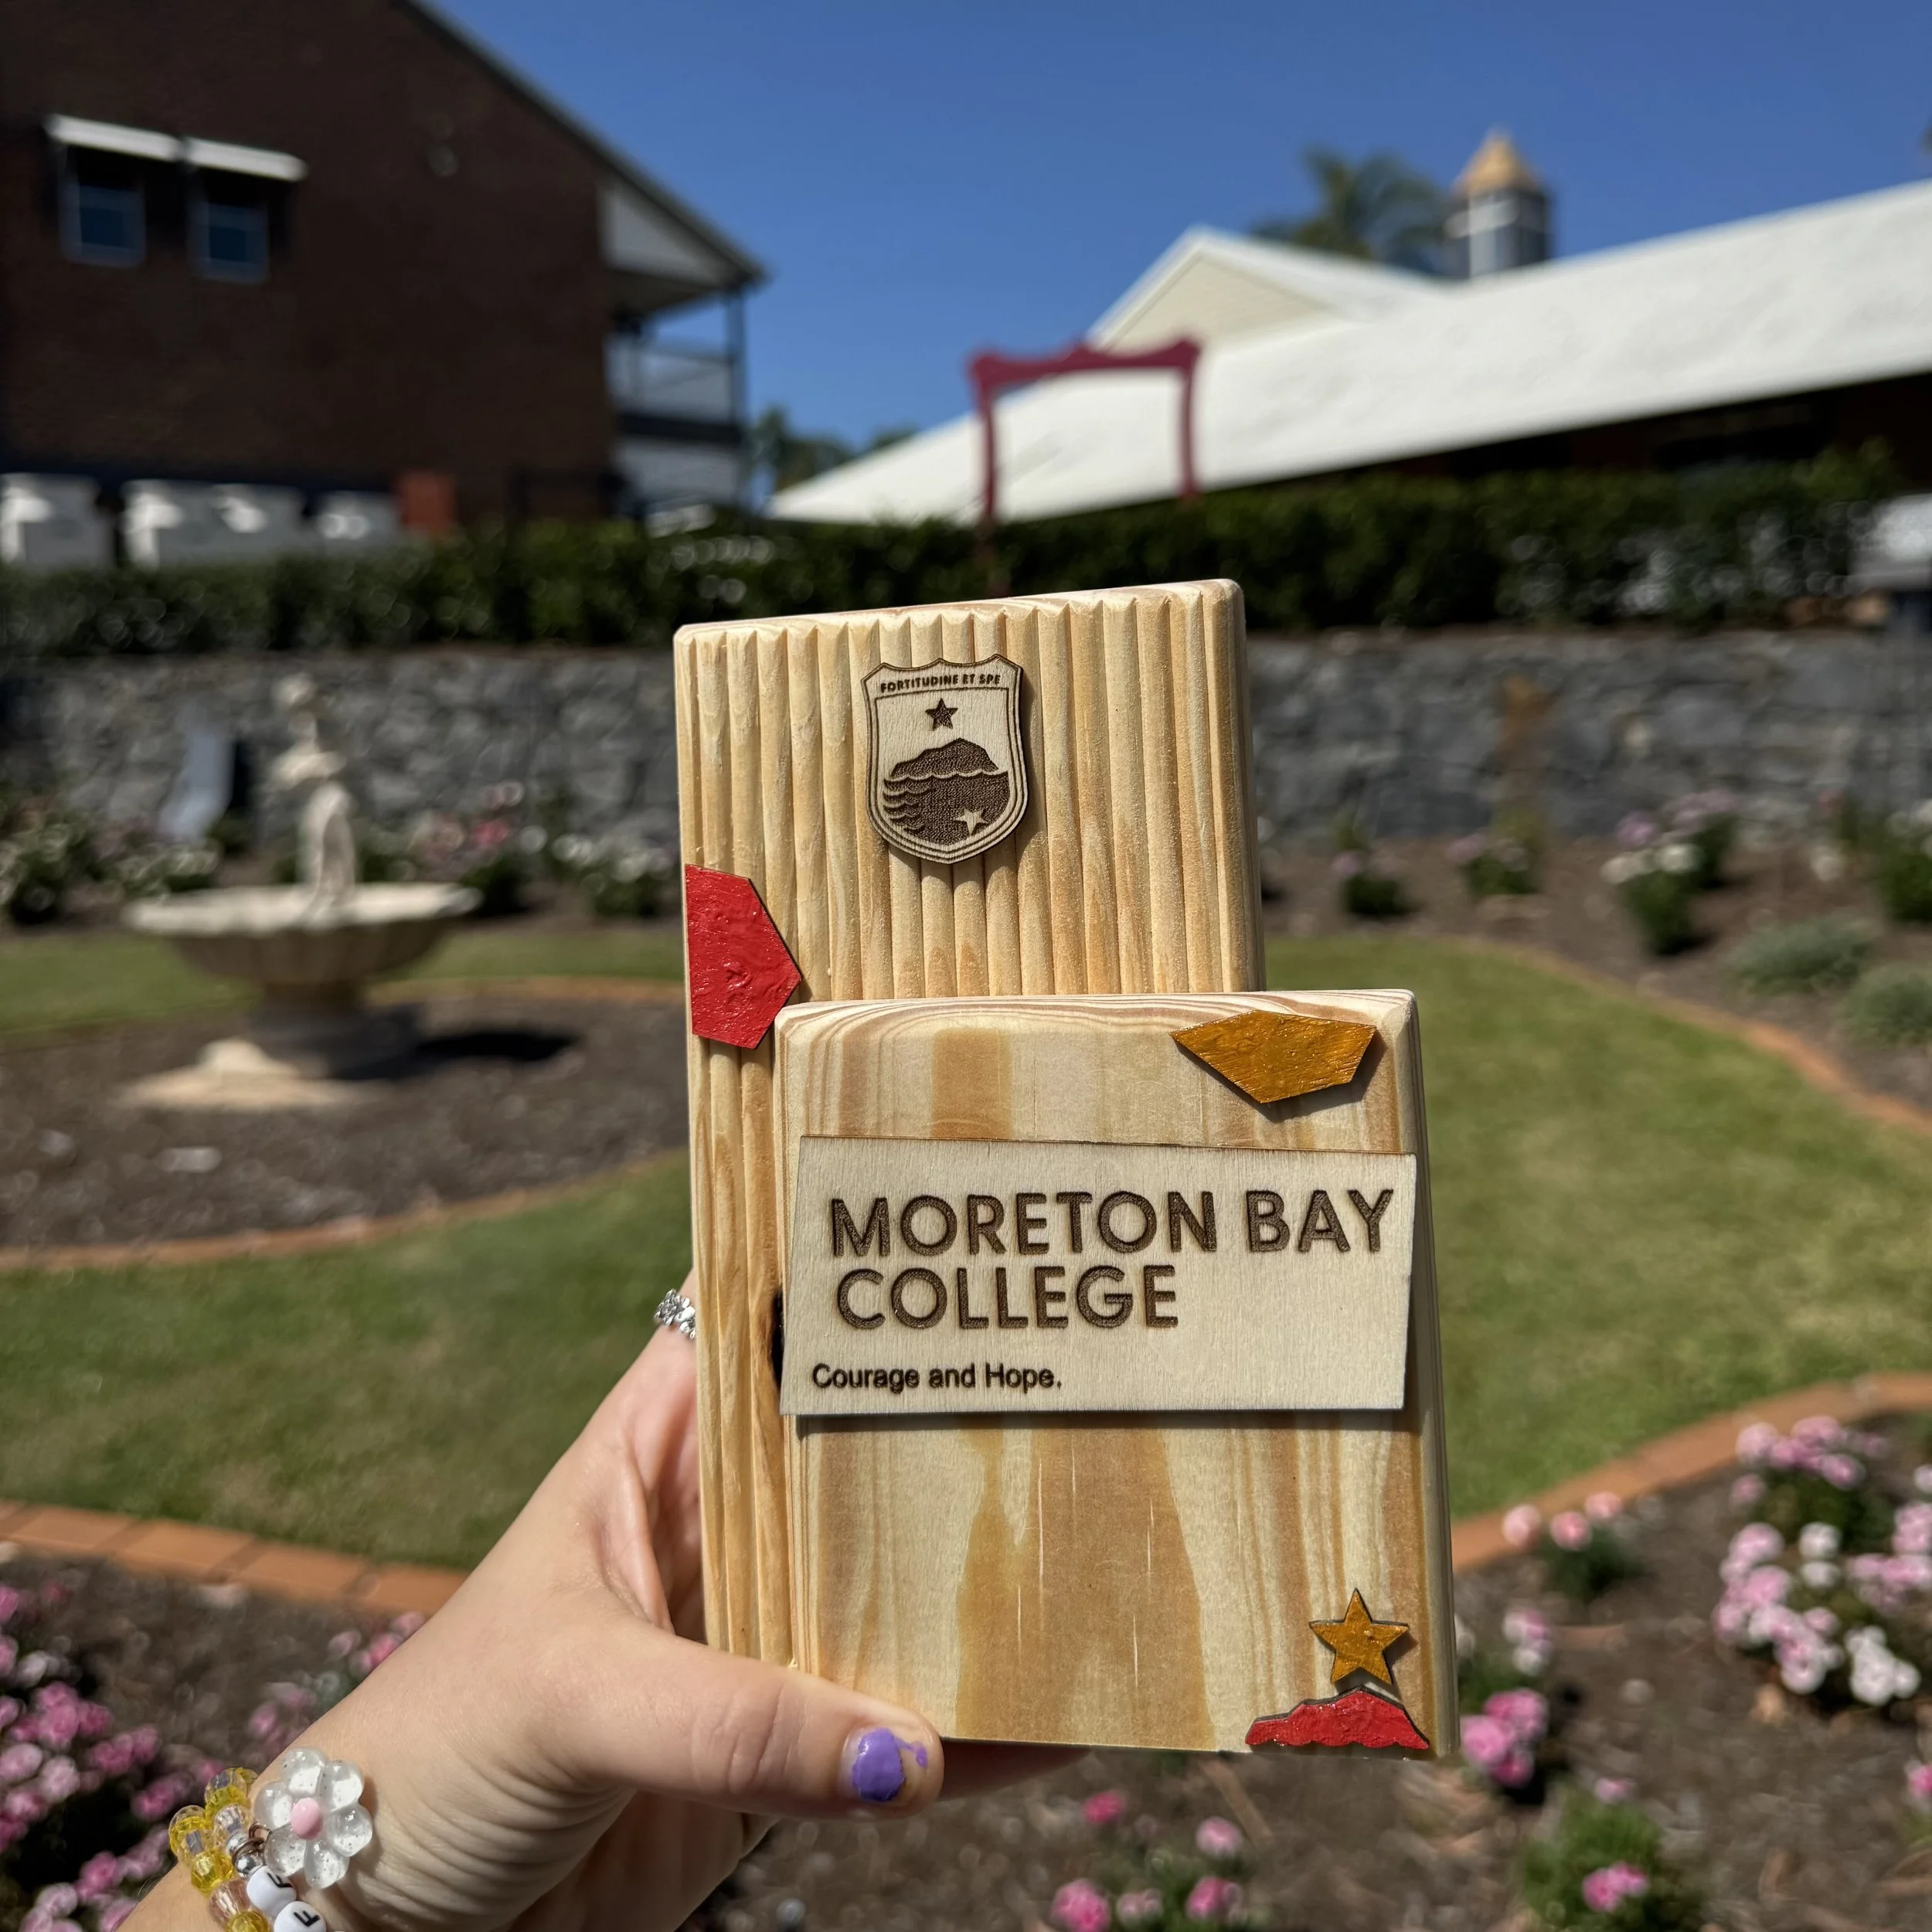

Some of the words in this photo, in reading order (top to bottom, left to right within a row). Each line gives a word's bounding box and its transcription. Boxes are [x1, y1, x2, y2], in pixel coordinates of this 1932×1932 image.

[880, 674, 958, 693] FORTITUDINE
[962, 673, 975, 685] ET
[979, 673, 1001, 685] SPE
[830, 1189, 1218, 1257] MORETON
[1244, 1188, 1395, 1253] BAY
[835, 1264, 1179, 1330] COLLEGE
[812, 1362, 920, 1395] Courage
[928, 1362, 975, 1389] and
[985, 1362, 1063, 1394] Hope.
